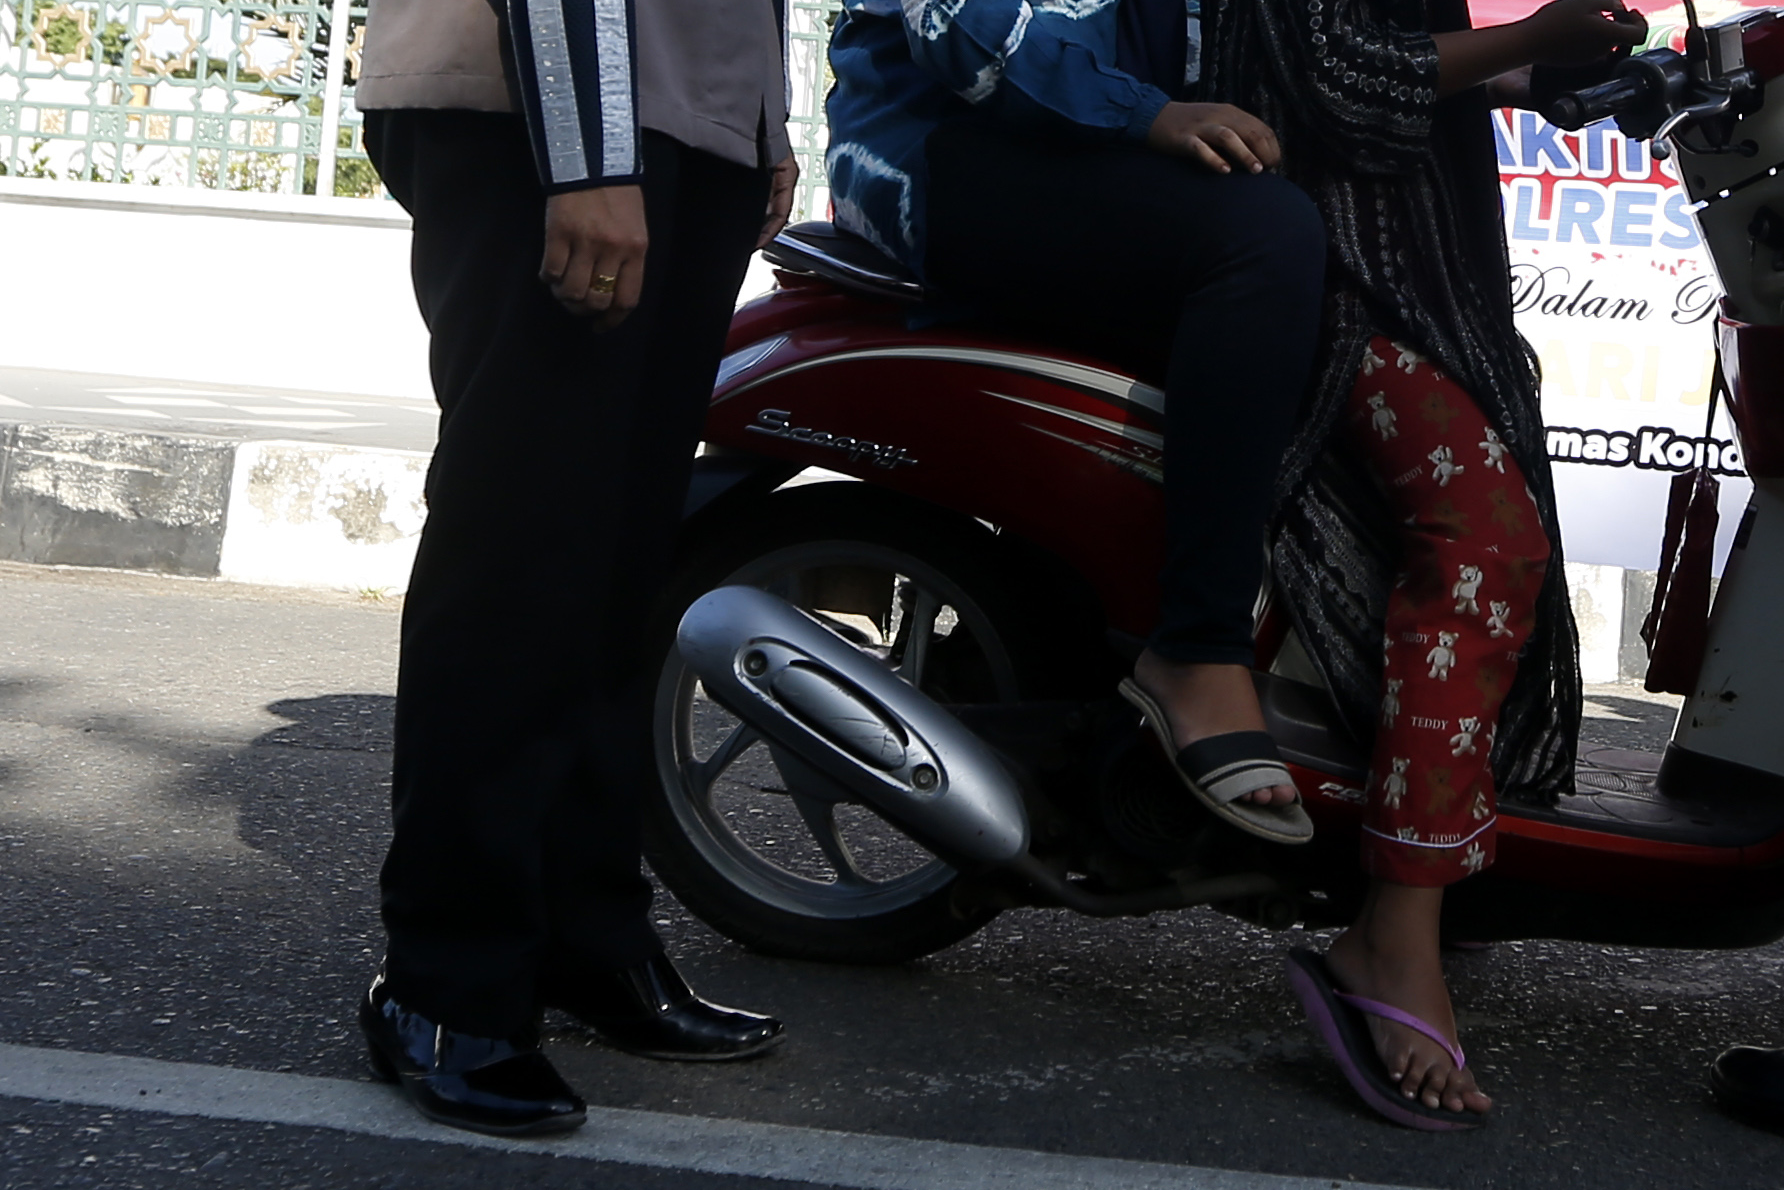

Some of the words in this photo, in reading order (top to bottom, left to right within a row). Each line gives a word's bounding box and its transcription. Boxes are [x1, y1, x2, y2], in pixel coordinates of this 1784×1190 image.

[1500, 186, 1701, 250] LRES
[1510, 264, 1653, 321] Dalam
[1411, 715, 1449, 731] TEDDY
